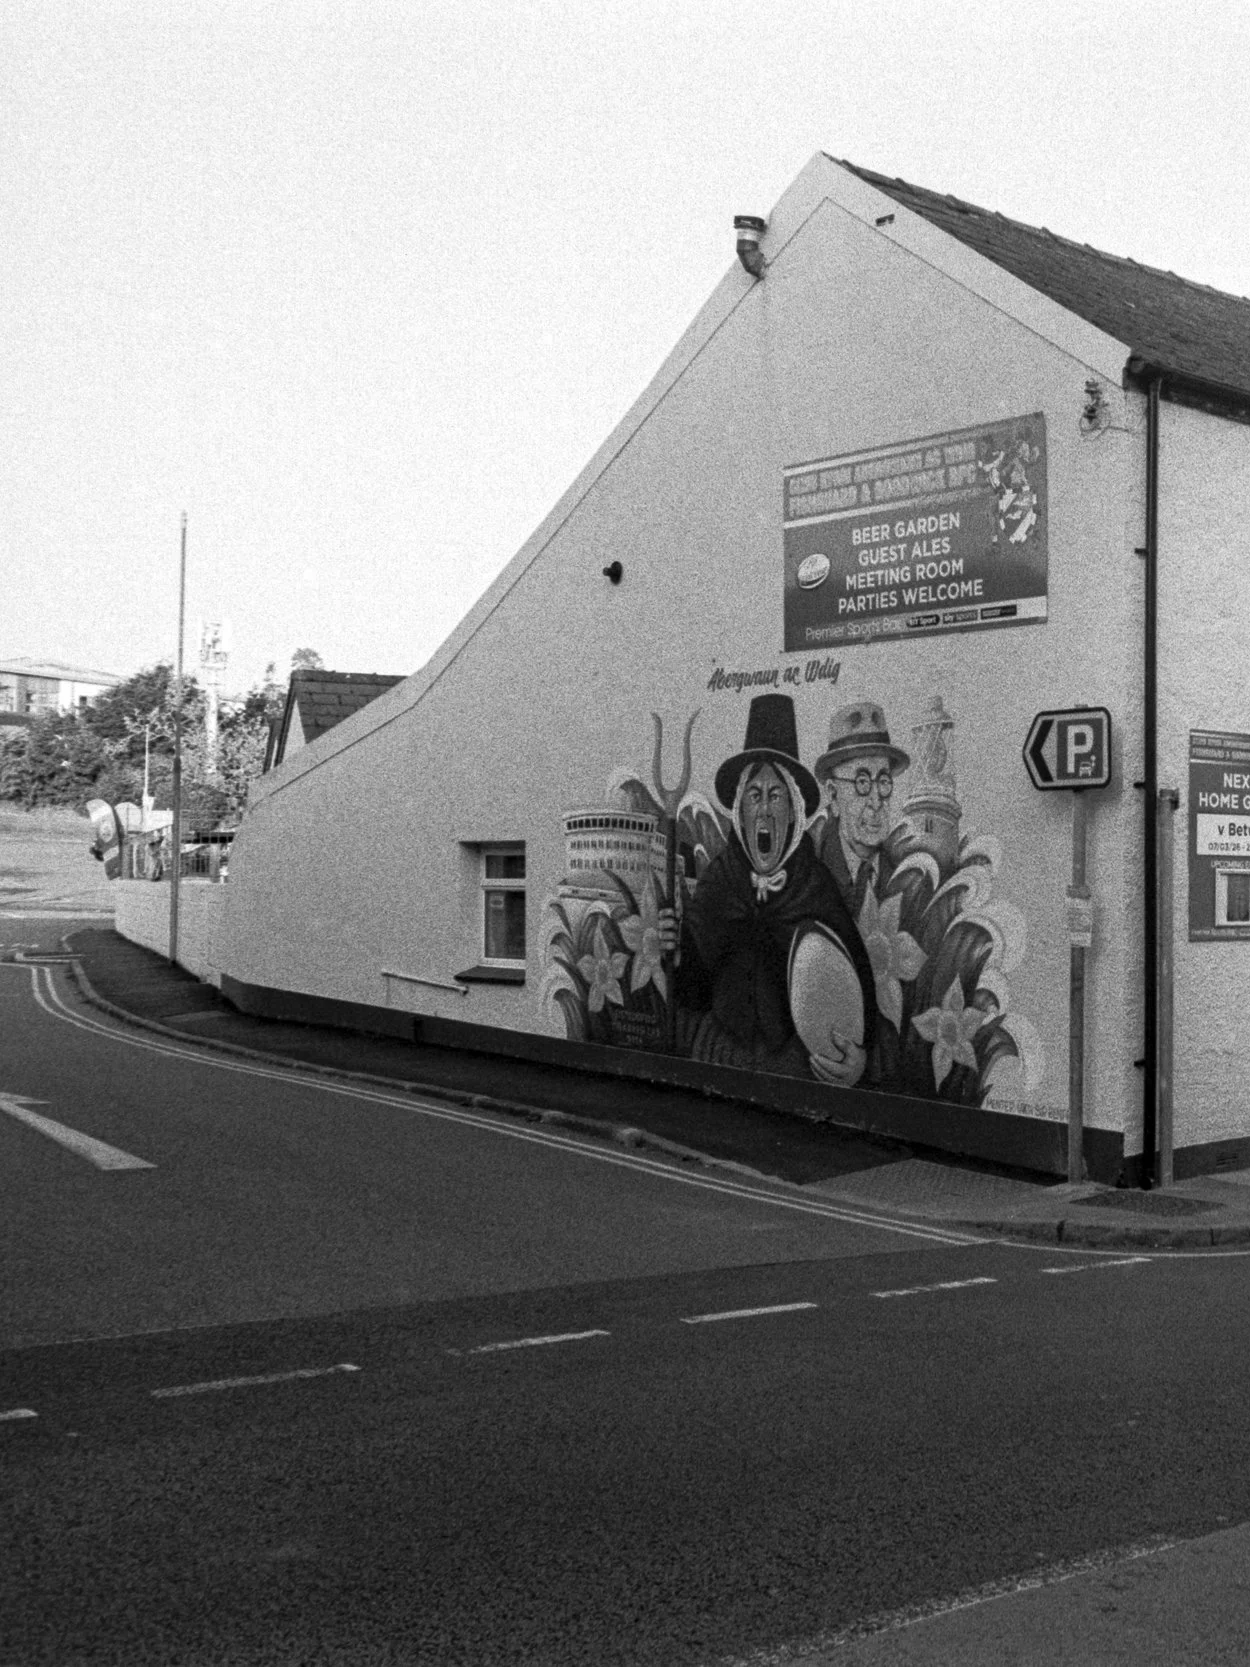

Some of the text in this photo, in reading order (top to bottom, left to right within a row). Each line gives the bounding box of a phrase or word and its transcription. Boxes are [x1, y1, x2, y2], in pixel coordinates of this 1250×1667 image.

[852, 513, 960, 545] BEER GARDEN
[858, 537, 951, 566] GUEST ALES
[846, 566, 911, 590] MEETING
[916, 558, 964, 578] ROOM
[838, 579, 984, 614] PARTIES WELCOME
[805, 625, 844, 641] Premier
[847, 620, 880, 637] Sports
[707, 657, 840, 693] Abergwaun ac Wdig
[1067, 725, 1094, 773] P
[1199, 792, 1238, 808] HOME
[1218, 825, 1224, 836] v
